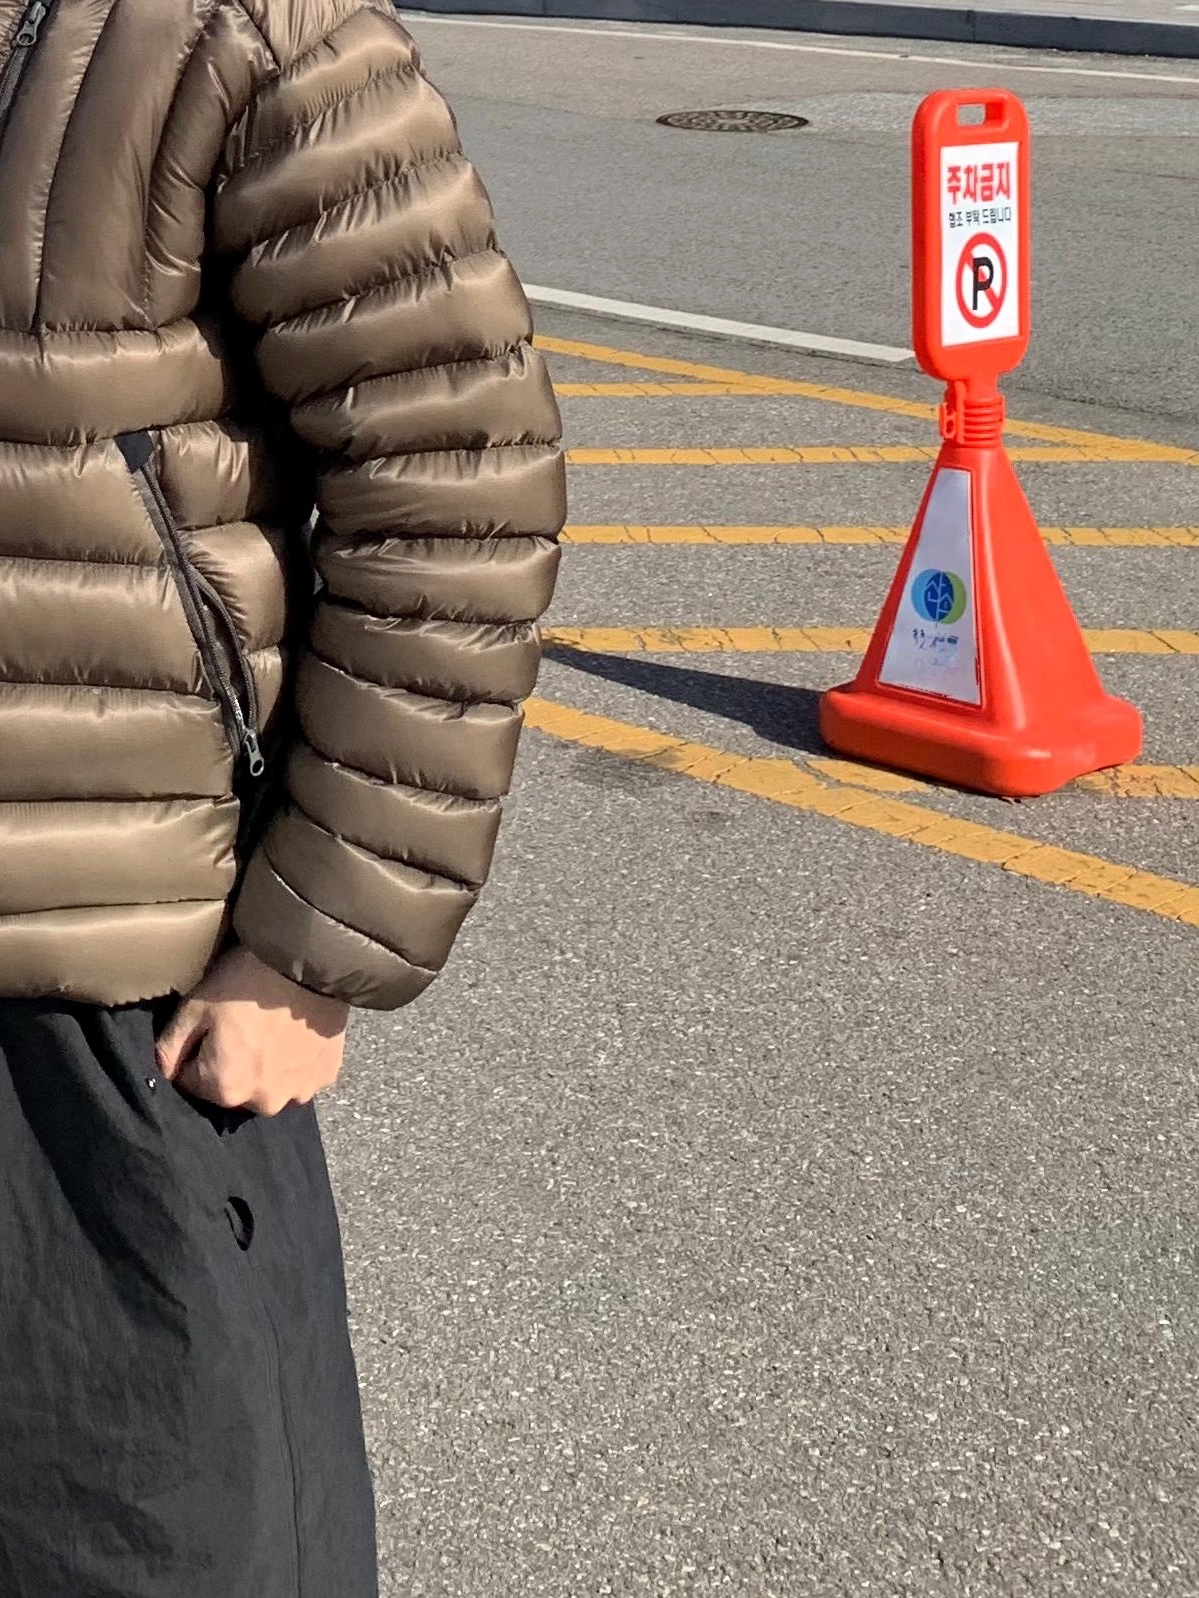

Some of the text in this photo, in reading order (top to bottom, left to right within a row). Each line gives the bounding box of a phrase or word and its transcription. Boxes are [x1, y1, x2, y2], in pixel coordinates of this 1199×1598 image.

[947, 162, 1010, 205] 주차금지
[948, 206, 1011, 228] 협조 부탁 드립니다
[972, 256, 994, 311] P
